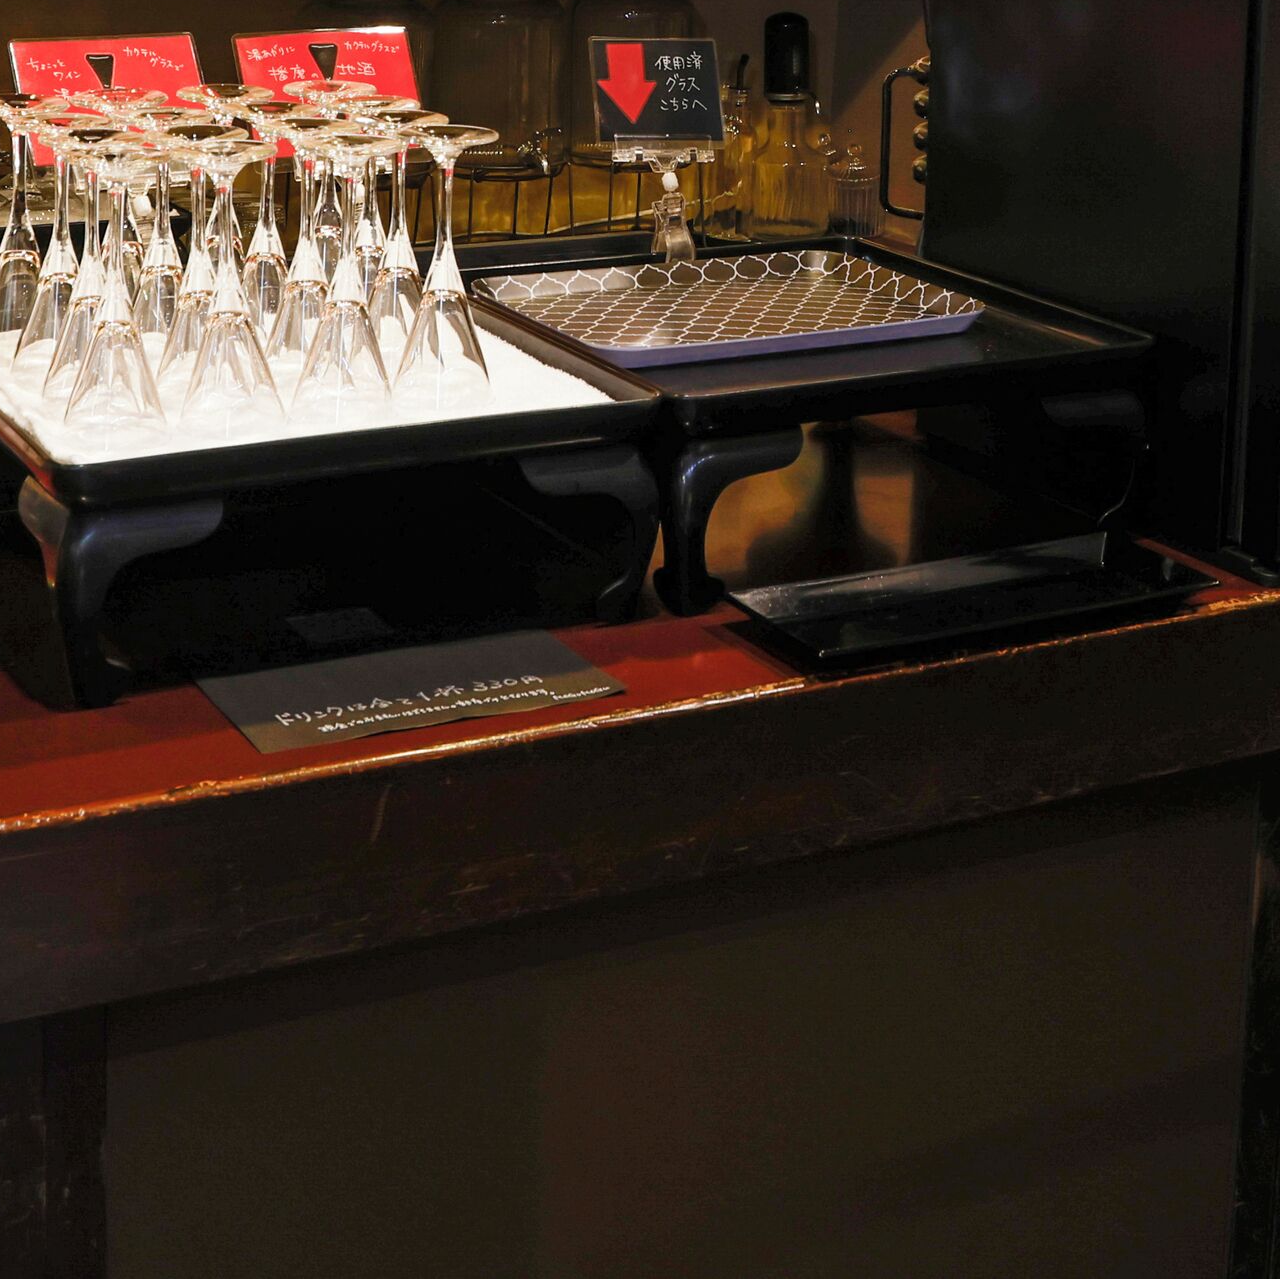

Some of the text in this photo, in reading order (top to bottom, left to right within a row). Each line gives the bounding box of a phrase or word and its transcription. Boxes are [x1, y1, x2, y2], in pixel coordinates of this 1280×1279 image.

[123, 46, 156, 58] カクテル
[344, 40, 400, 54] カクテルグラスで
[26, 58, 66, 72] ちょこっと
[150, 55, 184, 71] グラスで
[654, 51, 704, 71] 使用済
[337, 61, 376, 76] 地酒
[53, 71, 81, 81] ワイン
[666, 73, 700, 93] グラス
[660, 97, 708, 111] こちらへ
